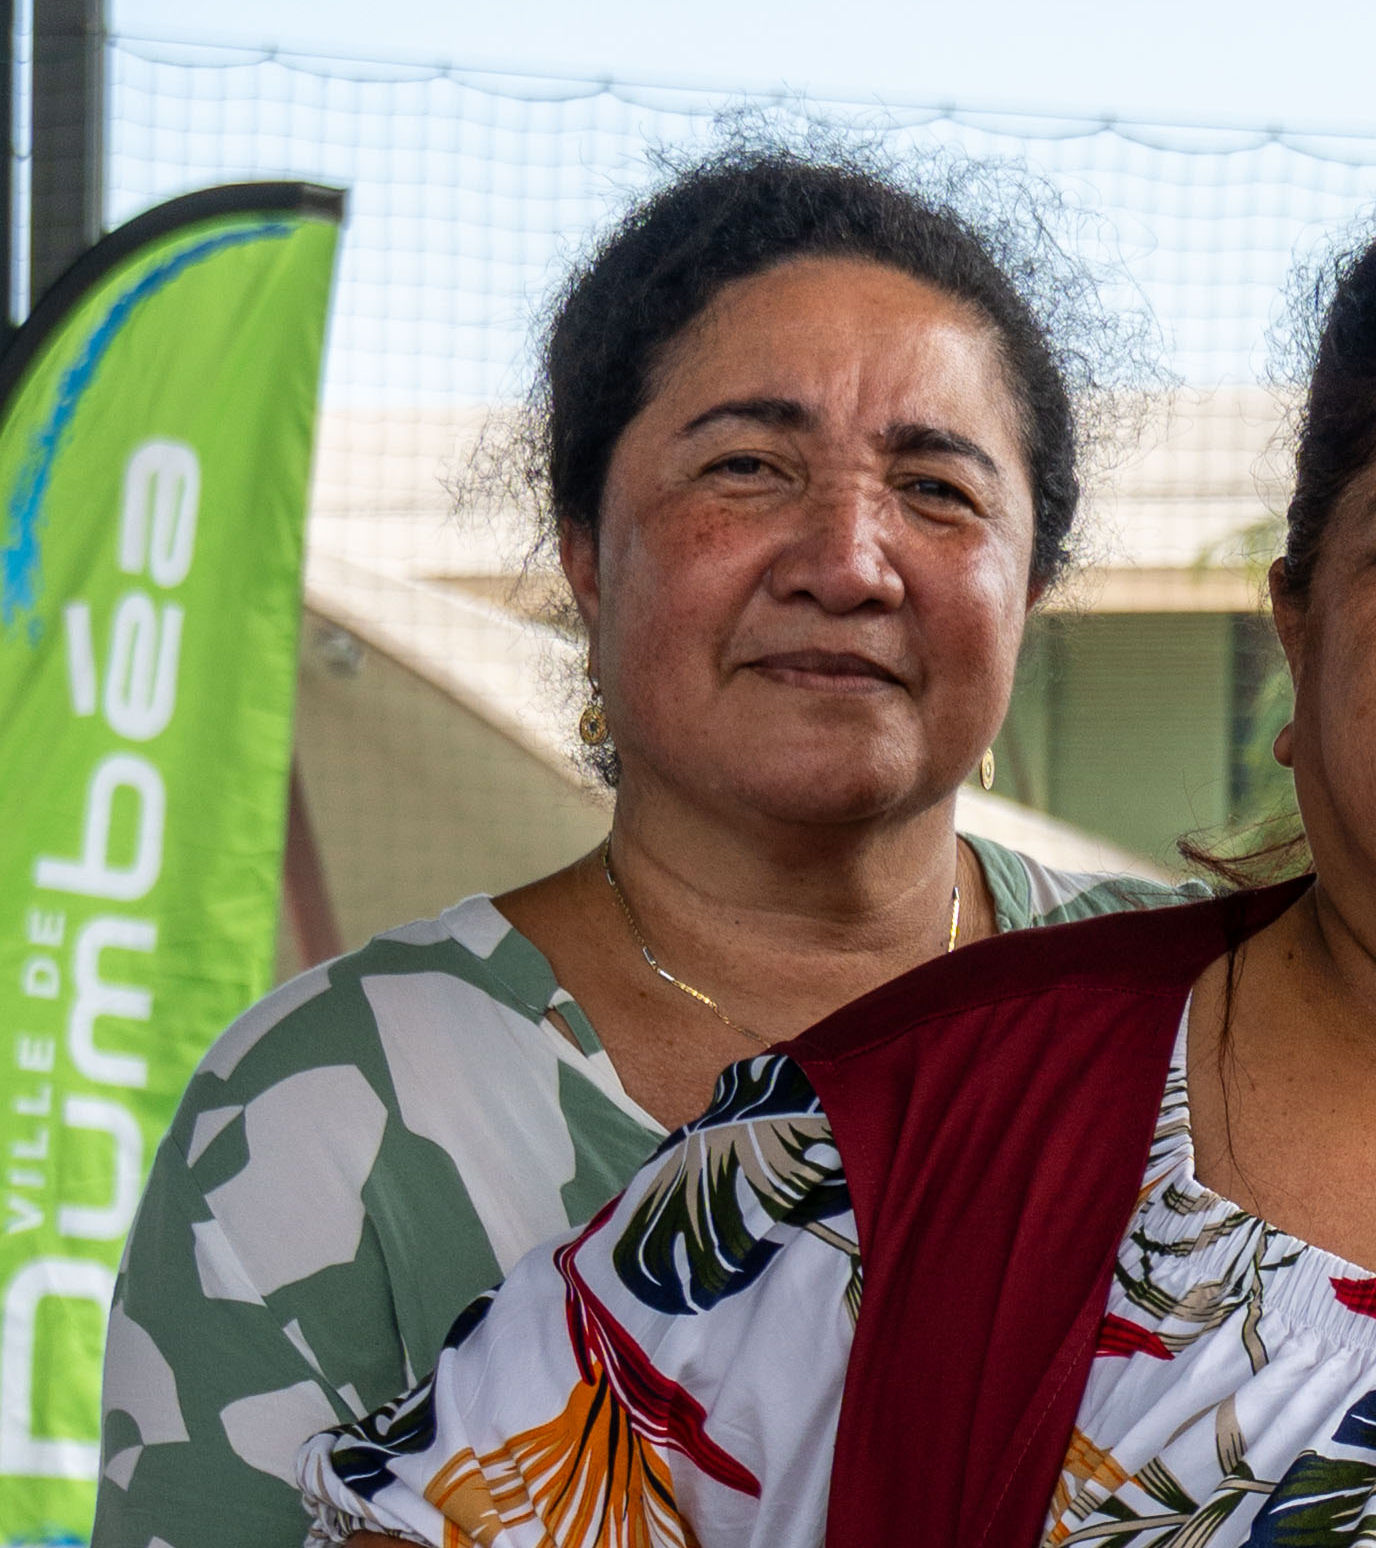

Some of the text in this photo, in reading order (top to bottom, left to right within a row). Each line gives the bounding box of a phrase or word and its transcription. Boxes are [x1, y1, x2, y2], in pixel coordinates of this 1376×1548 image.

[2, 437, 201, 1480] Dumbéa
[5, 907, 67, 1235] VILLE DE
